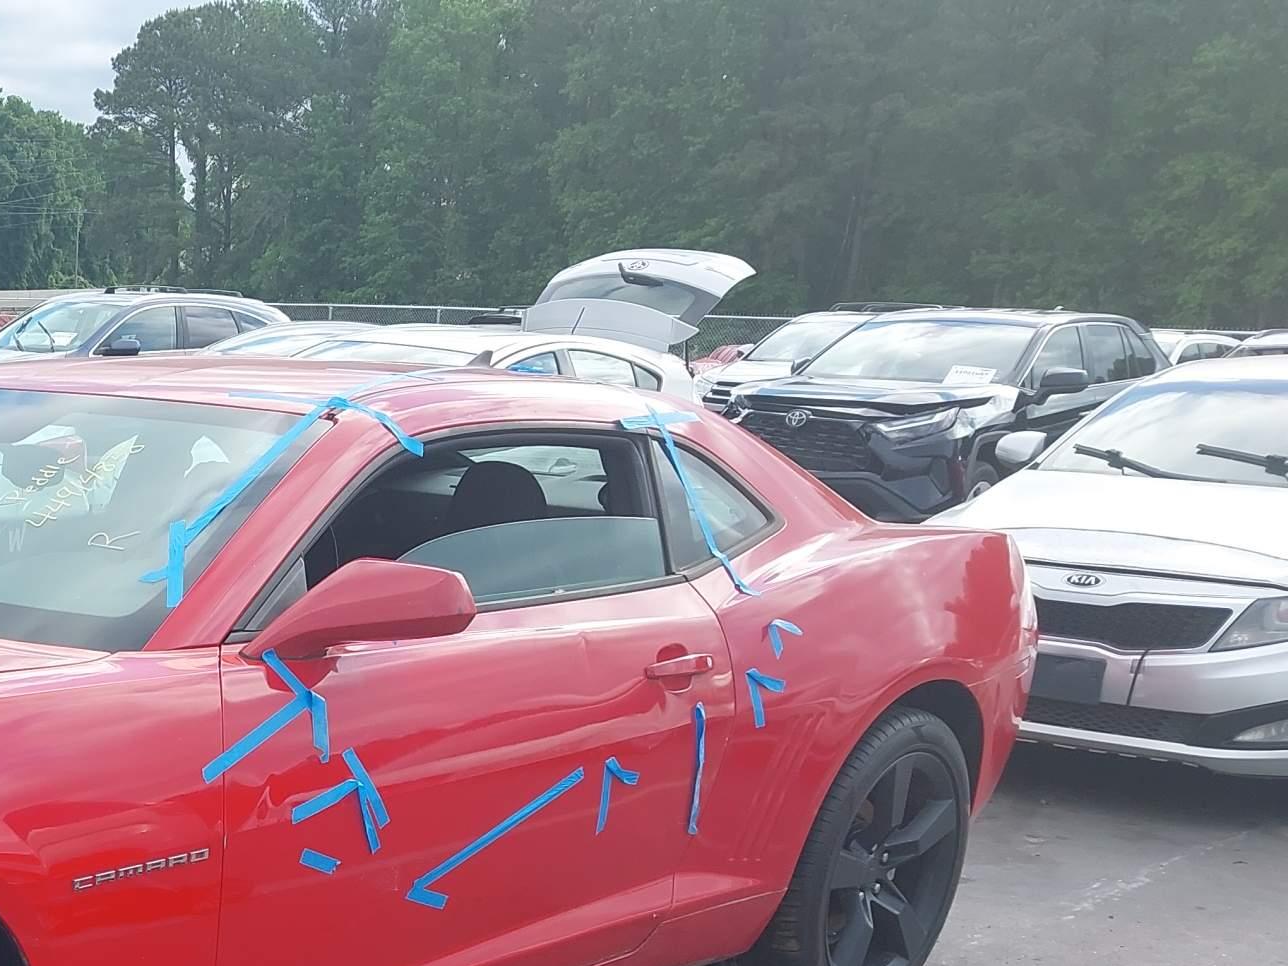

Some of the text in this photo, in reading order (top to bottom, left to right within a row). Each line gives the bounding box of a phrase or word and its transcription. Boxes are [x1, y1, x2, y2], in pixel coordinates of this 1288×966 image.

[87, 531, 141, 550] R
[1070, 575, 1096, 585] KIA
[73, 848, 210, 890] CAMARO
